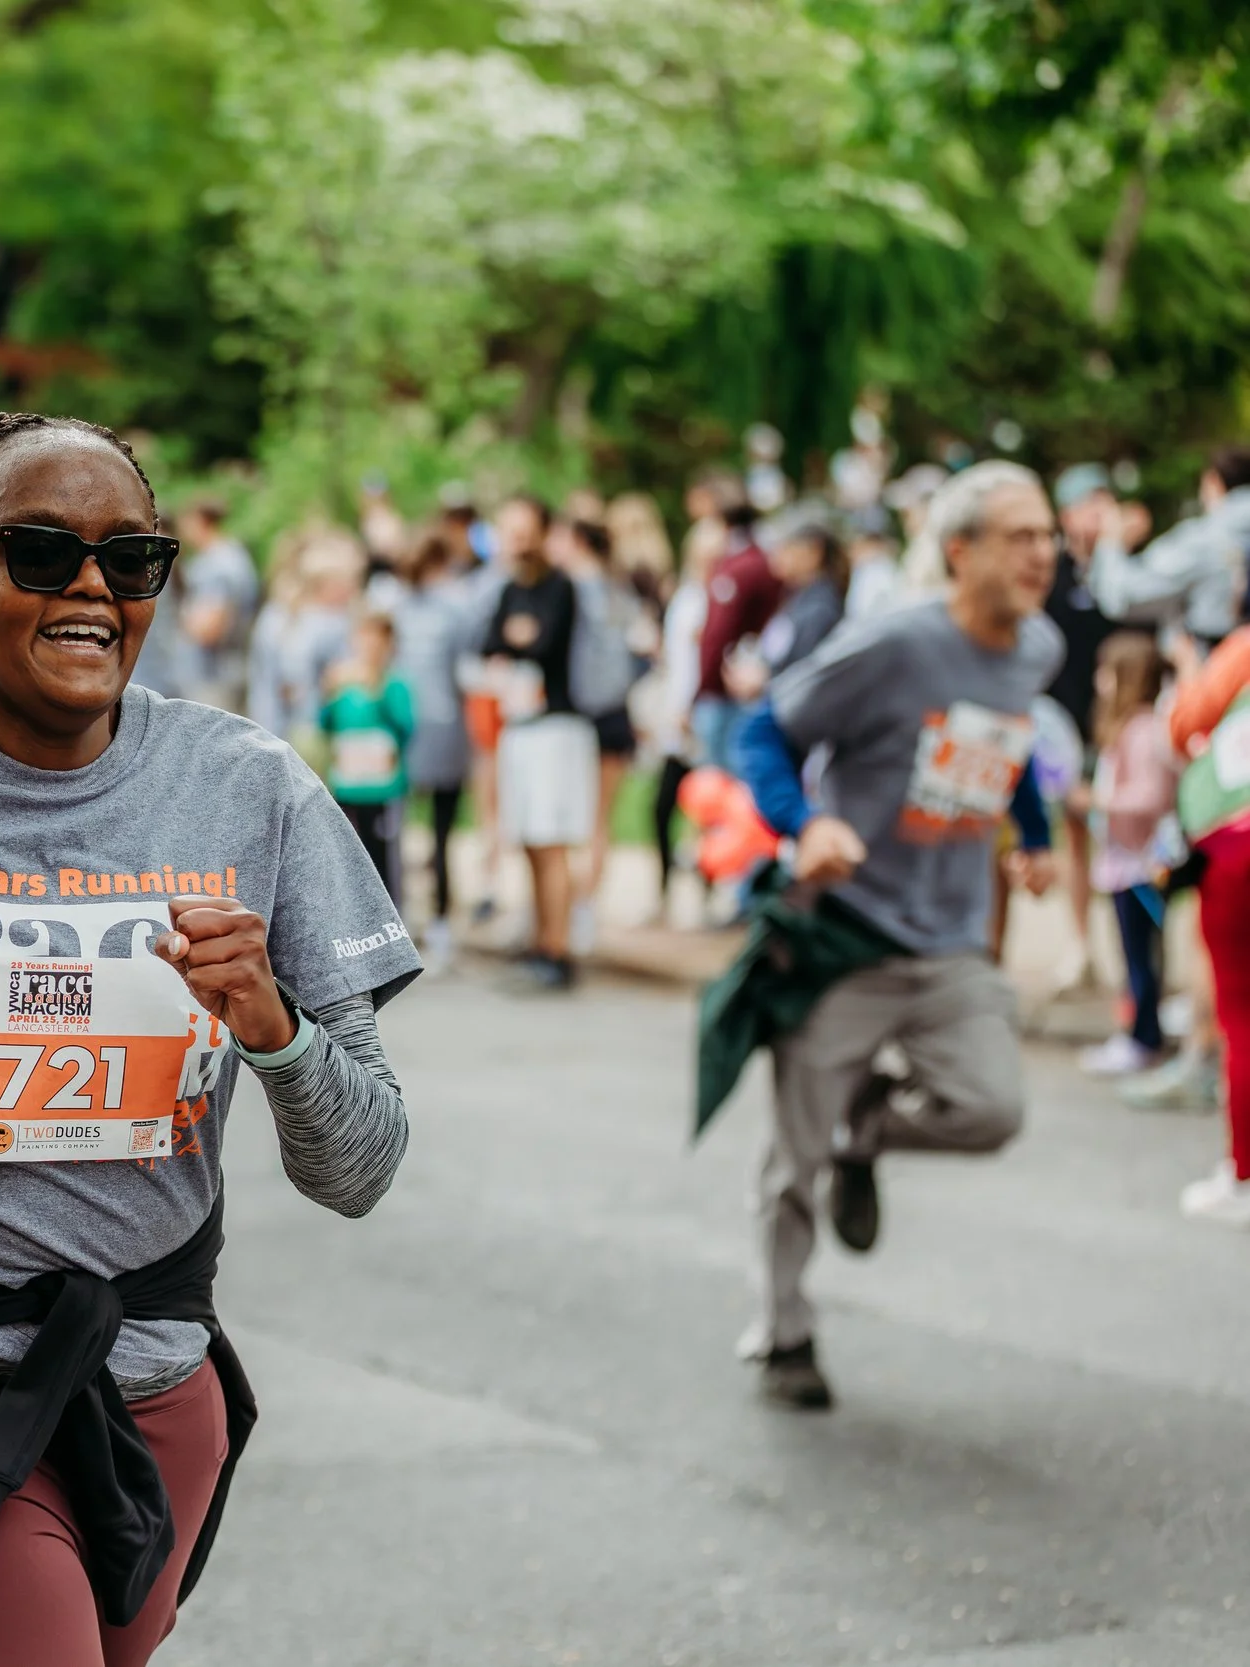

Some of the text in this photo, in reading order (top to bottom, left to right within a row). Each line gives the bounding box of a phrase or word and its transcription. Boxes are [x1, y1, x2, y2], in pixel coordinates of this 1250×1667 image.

[58, 864, 237, 898] Running!
[332, 937, 389, 959] Fulton
[26, 962, 49, 970] Years
[51, 963, 93, 972] Running!
[9, 971, 21, 1013] ywca
[22, 974, 92, 995] race
[24, 992, 90, 1005] against
[21, 999, 91, 1016] RACISM
[8, 1014, 91, 1025] APRIL 25, 2026
[8, 1024, 90, 1033] LANCASTER, PA
